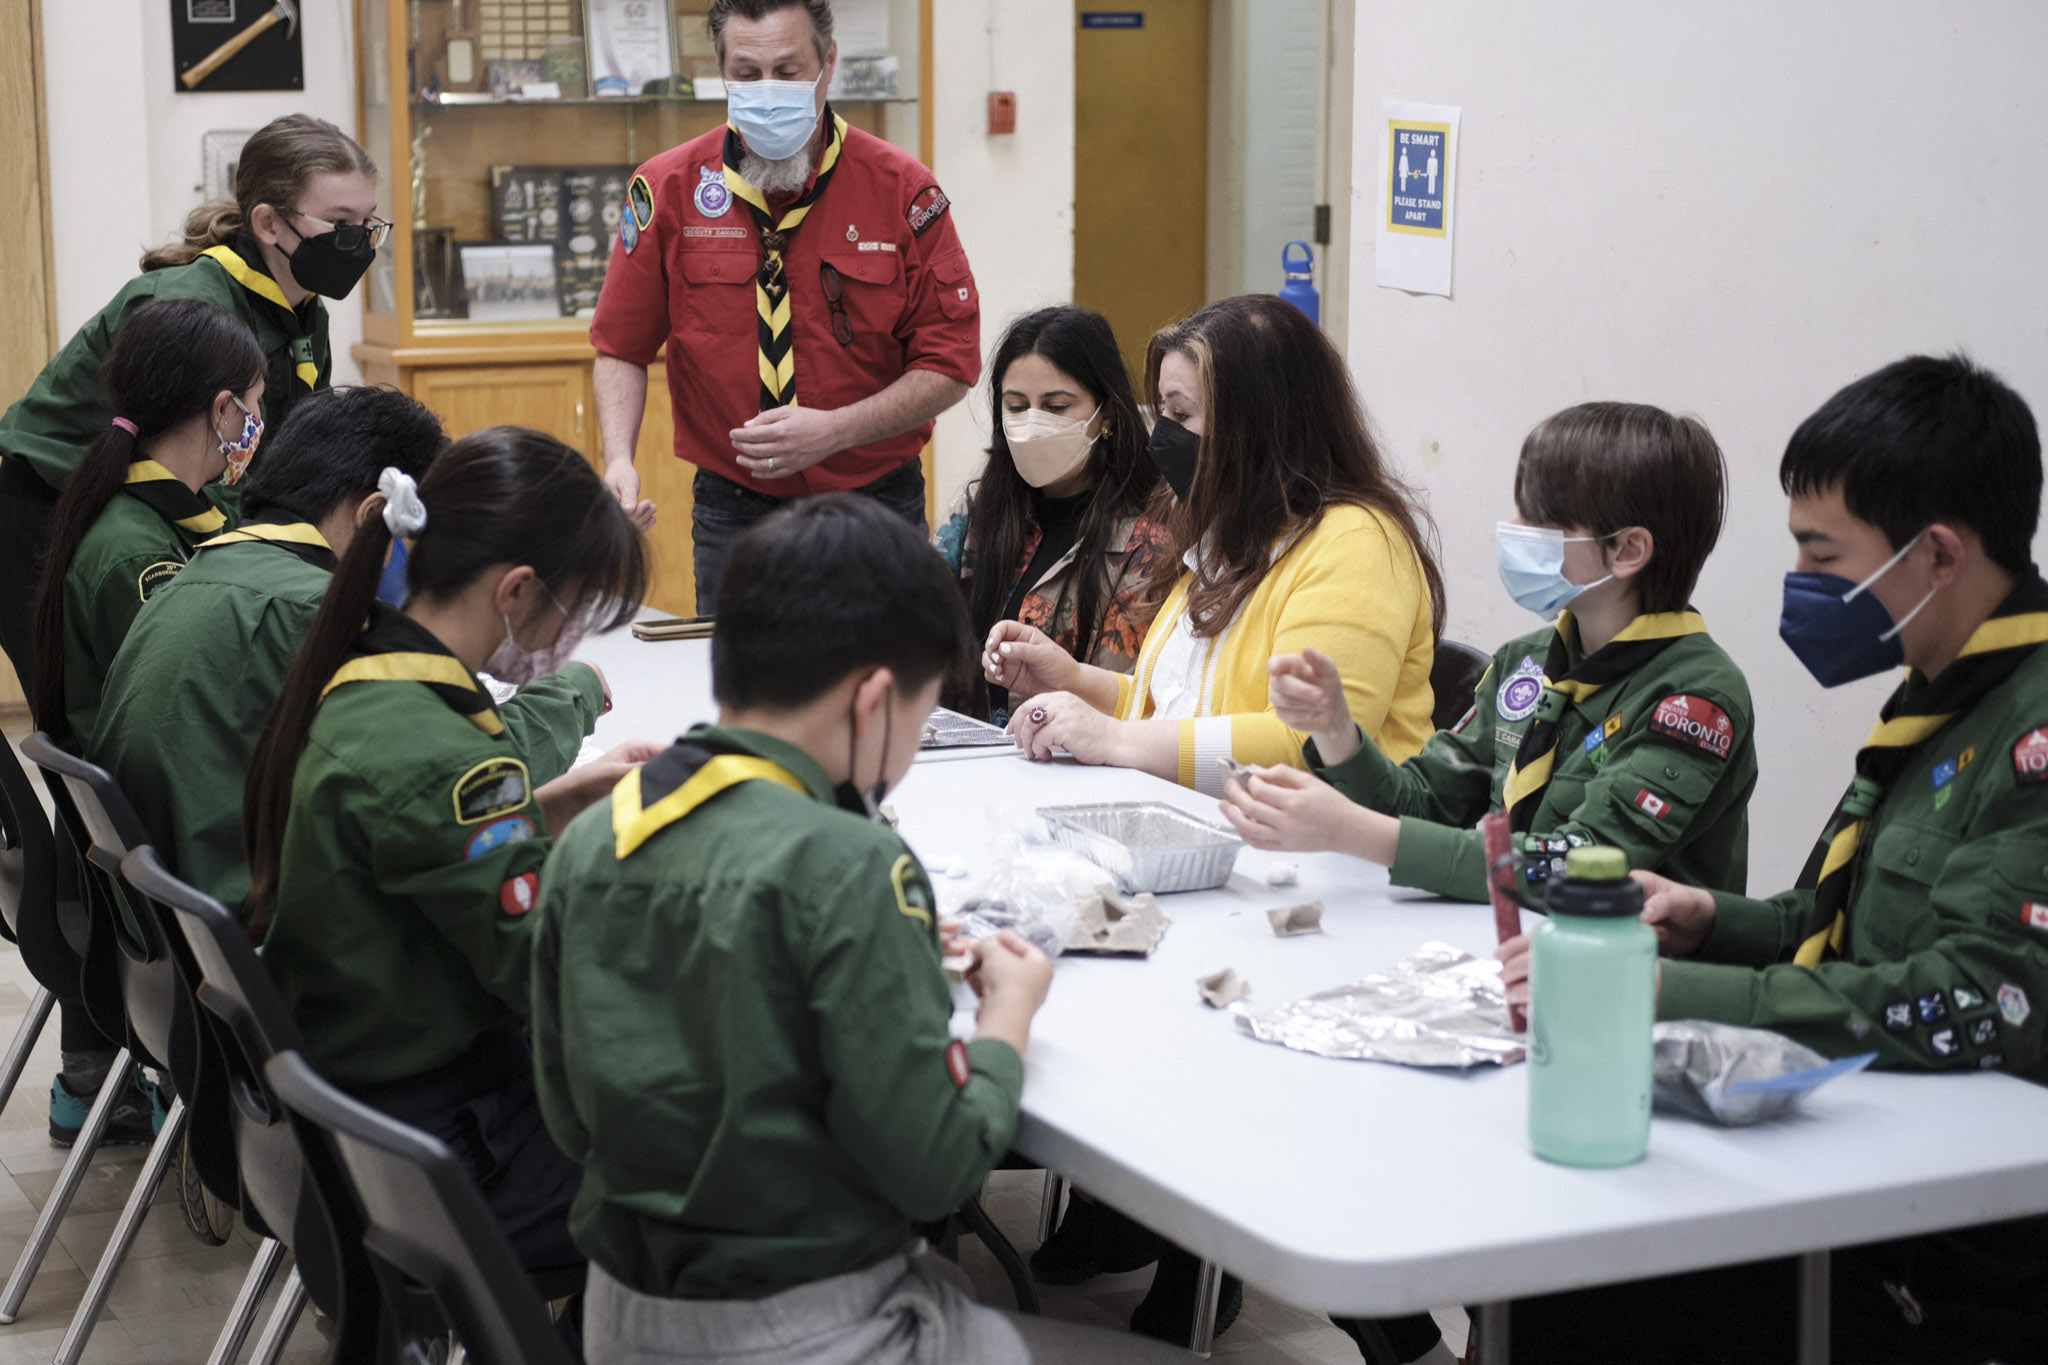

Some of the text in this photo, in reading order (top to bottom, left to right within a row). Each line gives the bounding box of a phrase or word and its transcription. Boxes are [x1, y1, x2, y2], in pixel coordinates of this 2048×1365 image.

[1400, 133, 1440, 147] BE SMART
[1394, 196, 1441, 210] PLEASE STAND
[910, 193, 946, 231] TORONTO
[1405, 210, 1427, 222] APART
[1657, 708, 1731, 749] TORONTO
[1501, 732, 1521, 746] CANA
